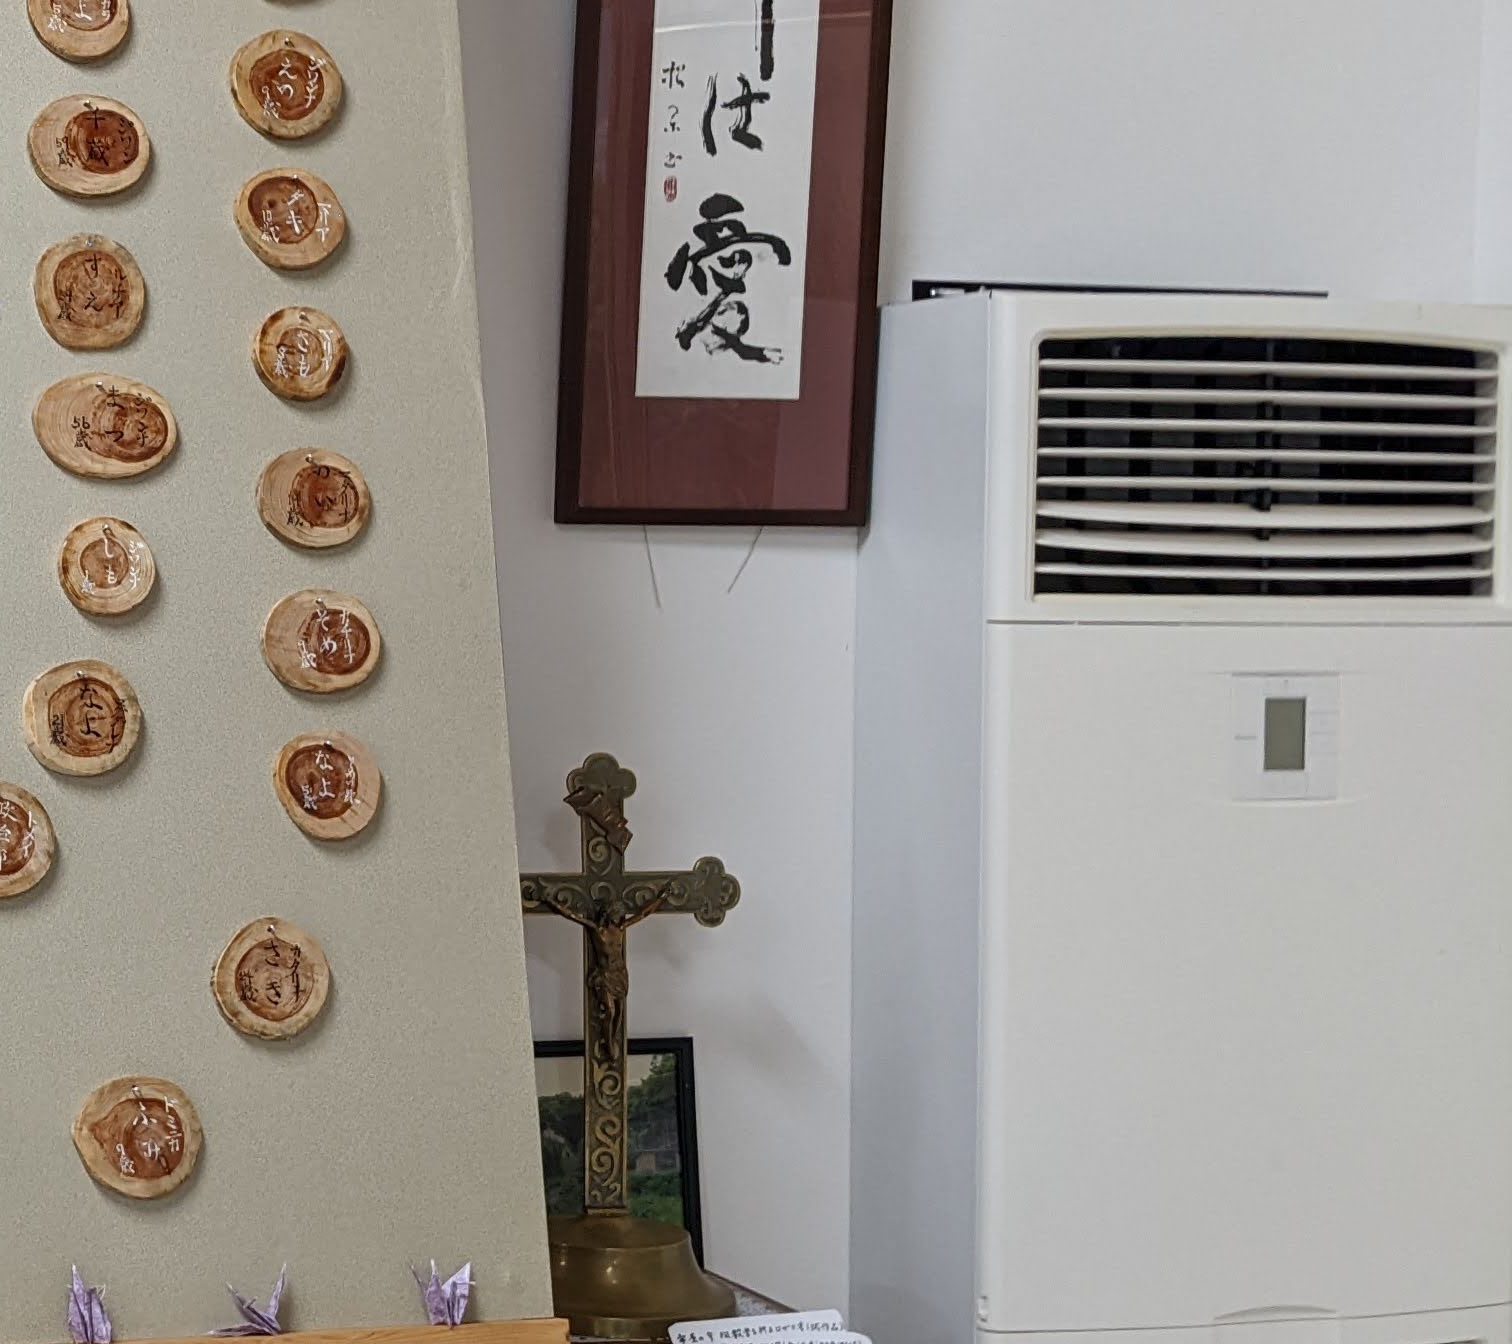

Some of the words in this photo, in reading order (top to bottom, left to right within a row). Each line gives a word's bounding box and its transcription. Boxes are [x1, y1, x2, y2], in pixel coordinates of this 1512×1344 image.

[104, 385, 125, 442] まつ
[80, 682, 104, 738] なよ
[315, 750, 335, 798] なよ
[264, 940, 281, 1005] さき
